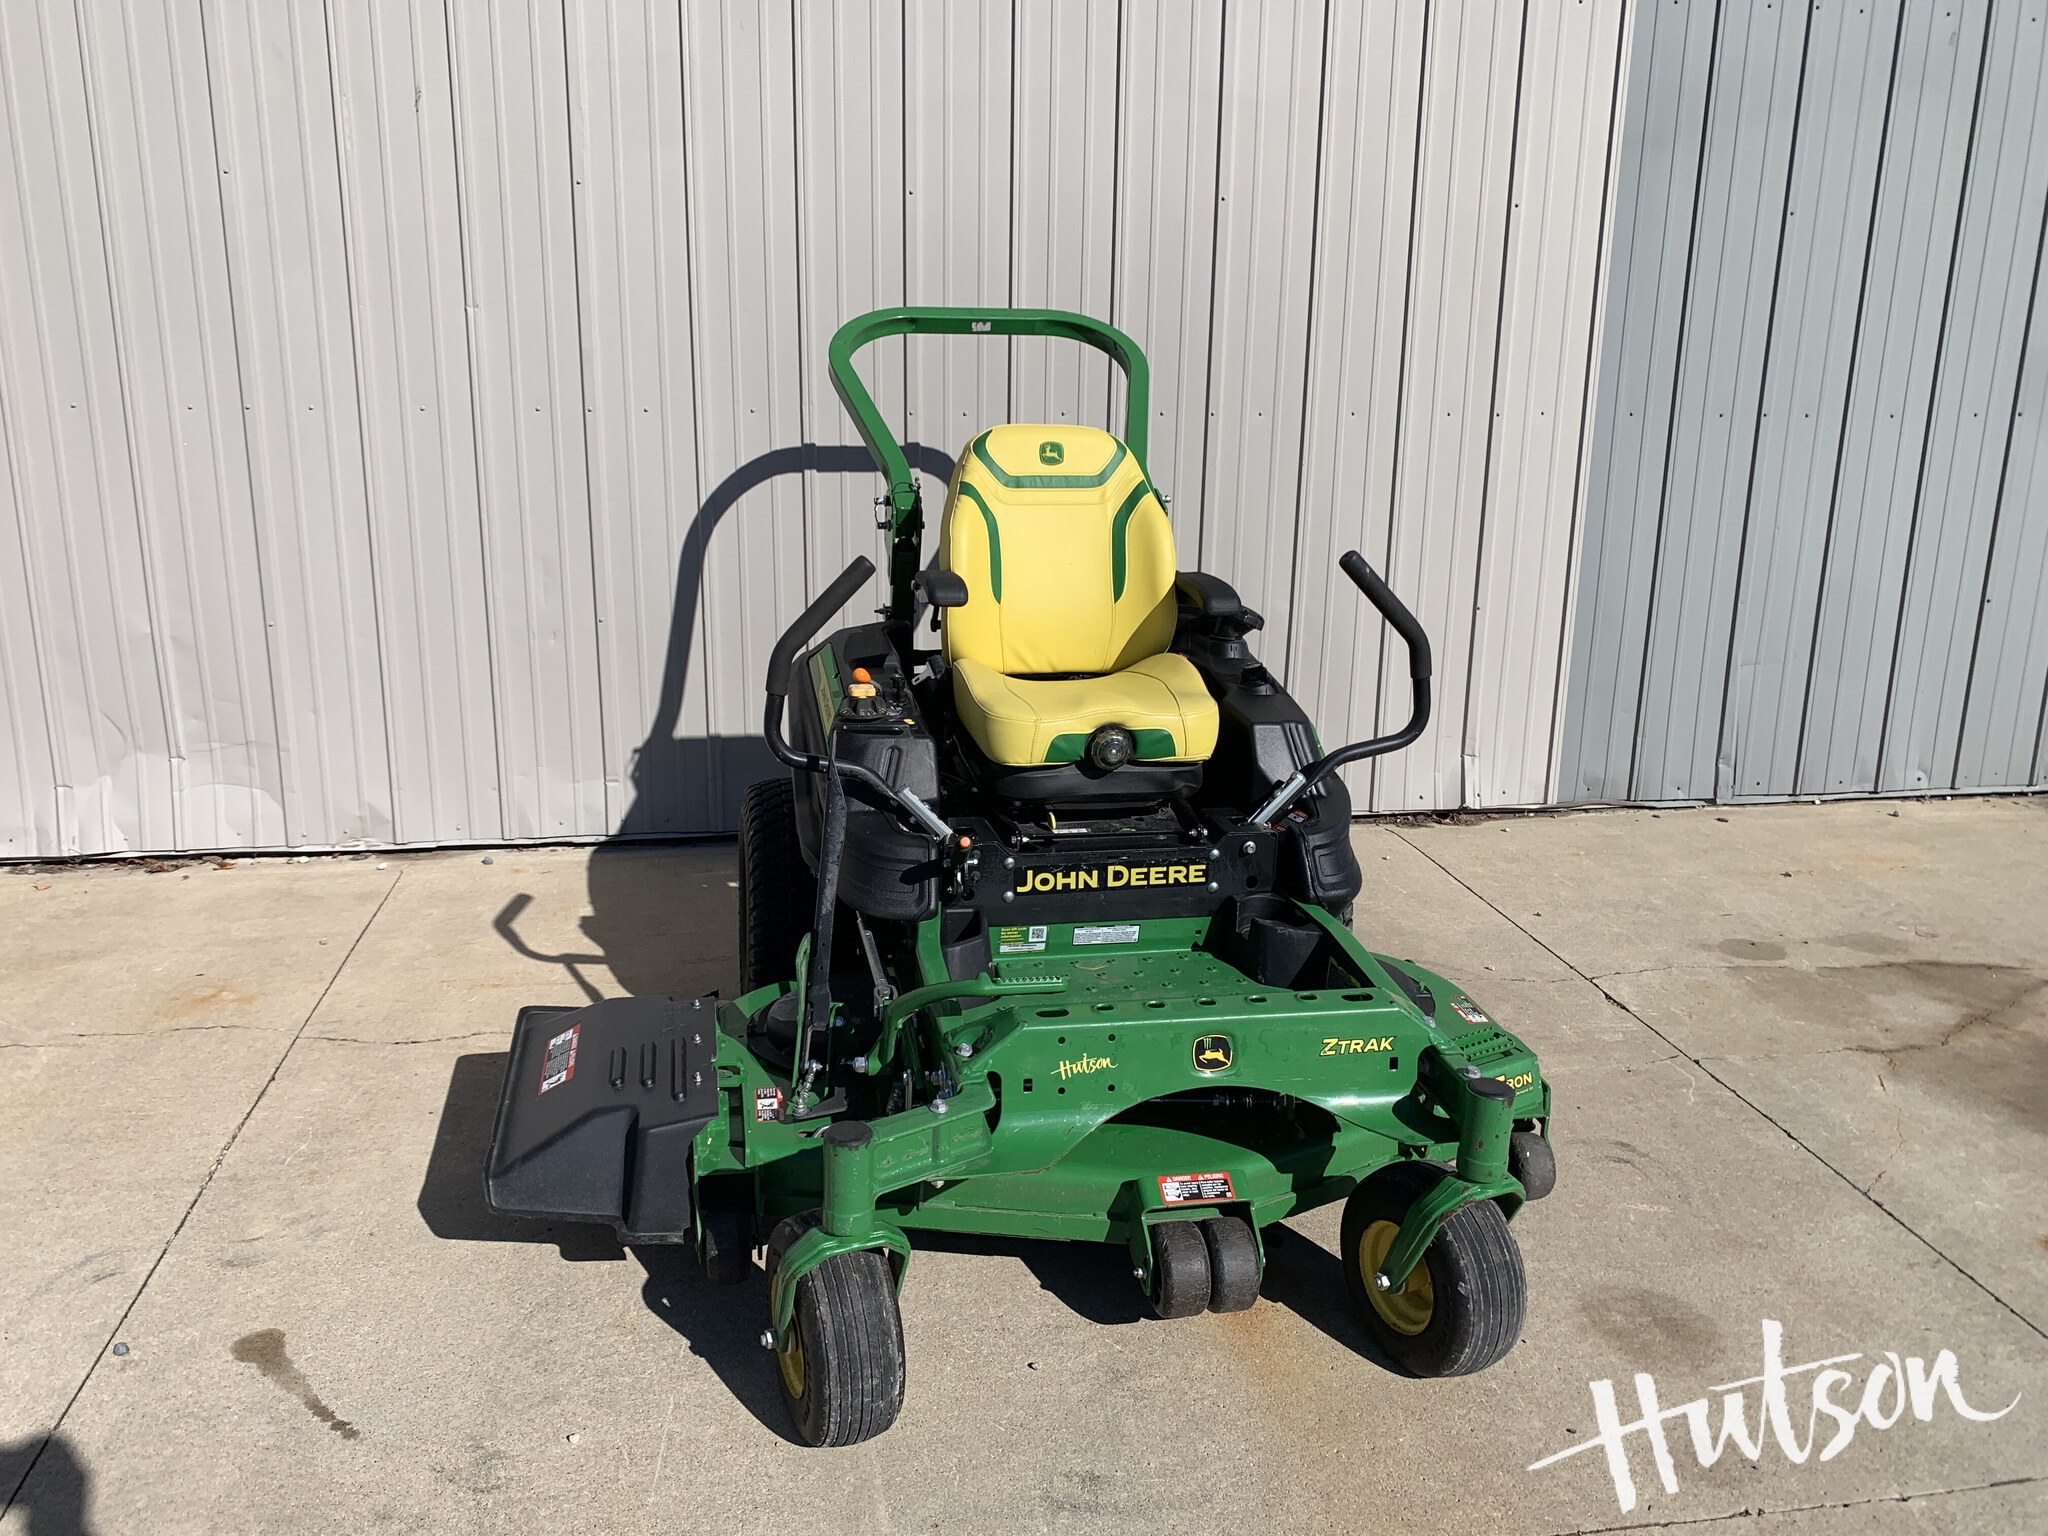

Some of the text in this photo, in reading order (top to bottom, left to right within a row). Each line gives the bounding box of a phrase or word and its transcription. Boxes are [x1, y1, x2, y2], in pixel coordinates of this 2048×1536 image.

[1016, 864, 1207, 893] JOHN DEERE
[1319, 1036, 1396, 1056] ZTRAK
[1050, 1052, 1119, 1080] Hutson
[1500, 1071, 1533, 1089] RON
